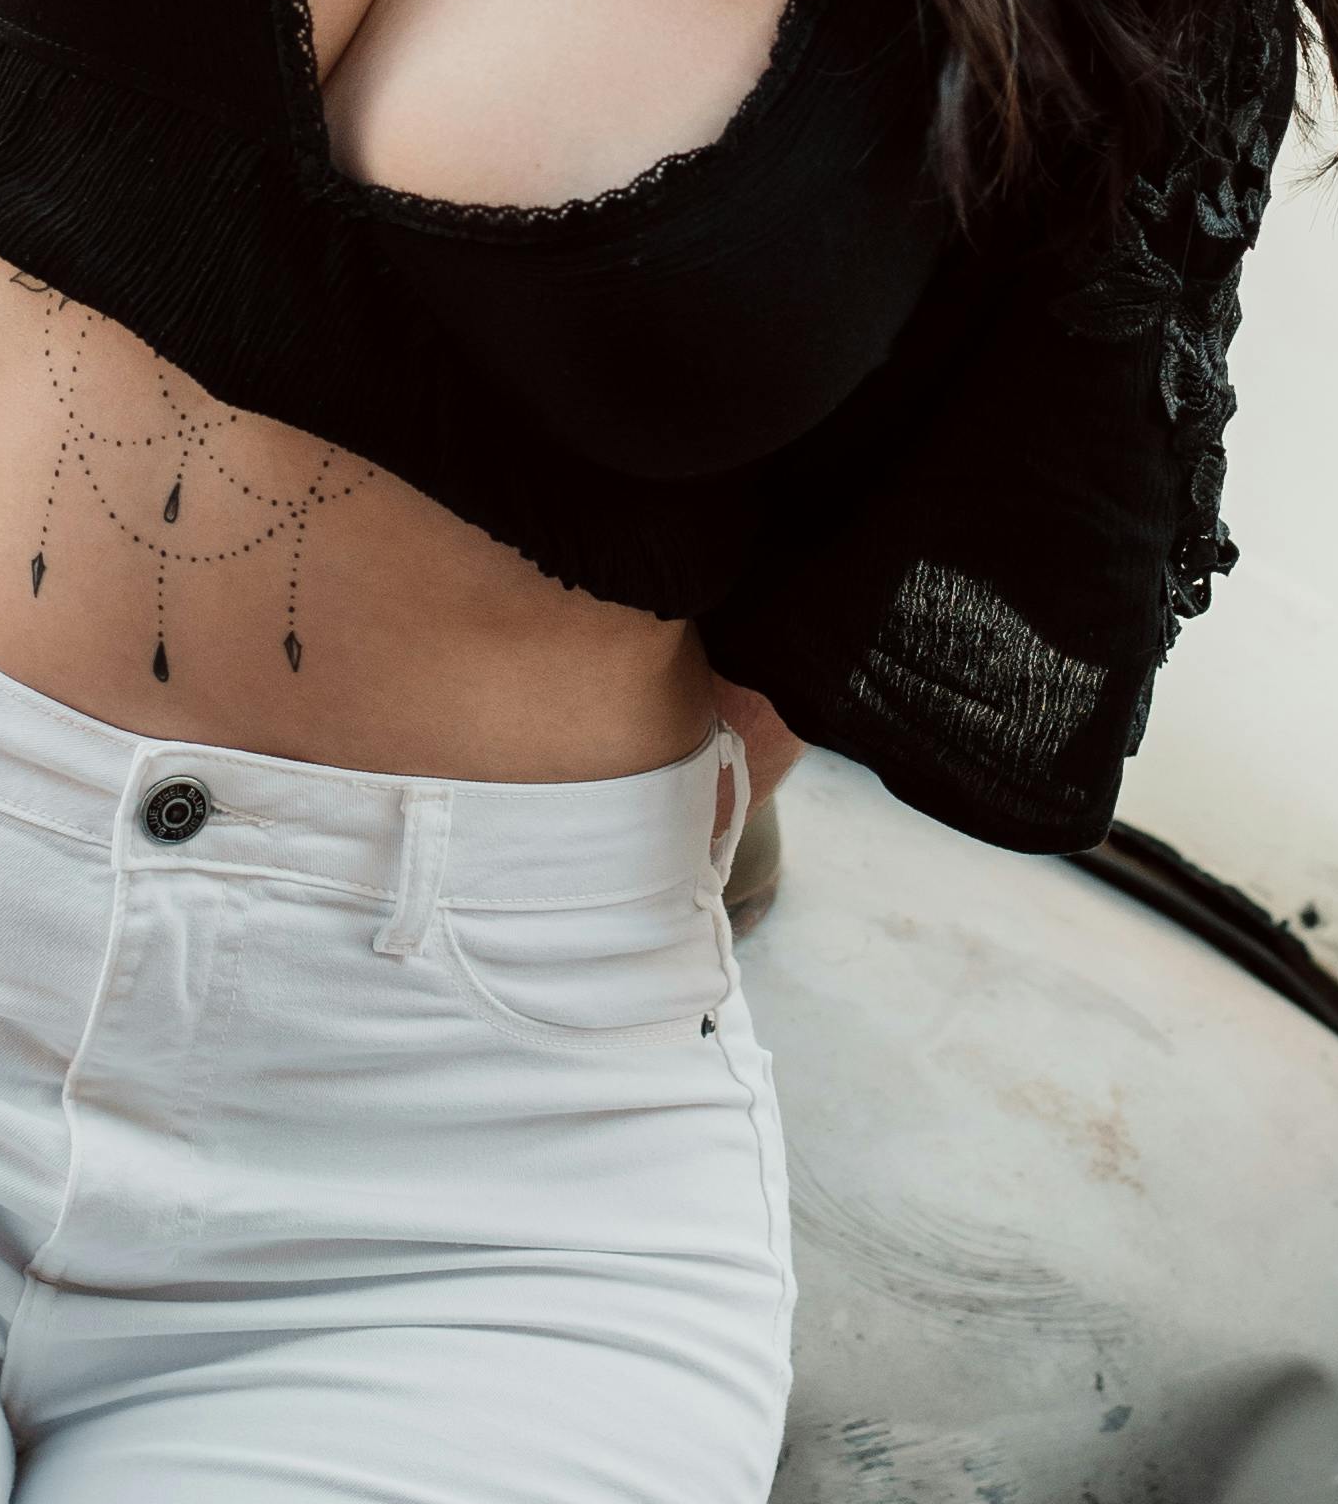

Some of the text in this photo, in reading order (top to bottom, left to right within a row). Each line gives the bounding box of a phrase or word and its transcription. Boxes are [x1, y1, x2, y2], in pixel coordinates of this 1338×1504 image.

[149, 786, 183, 838] BLUE STEEL
[171, 788, 204, 838] BLUE STEEL
